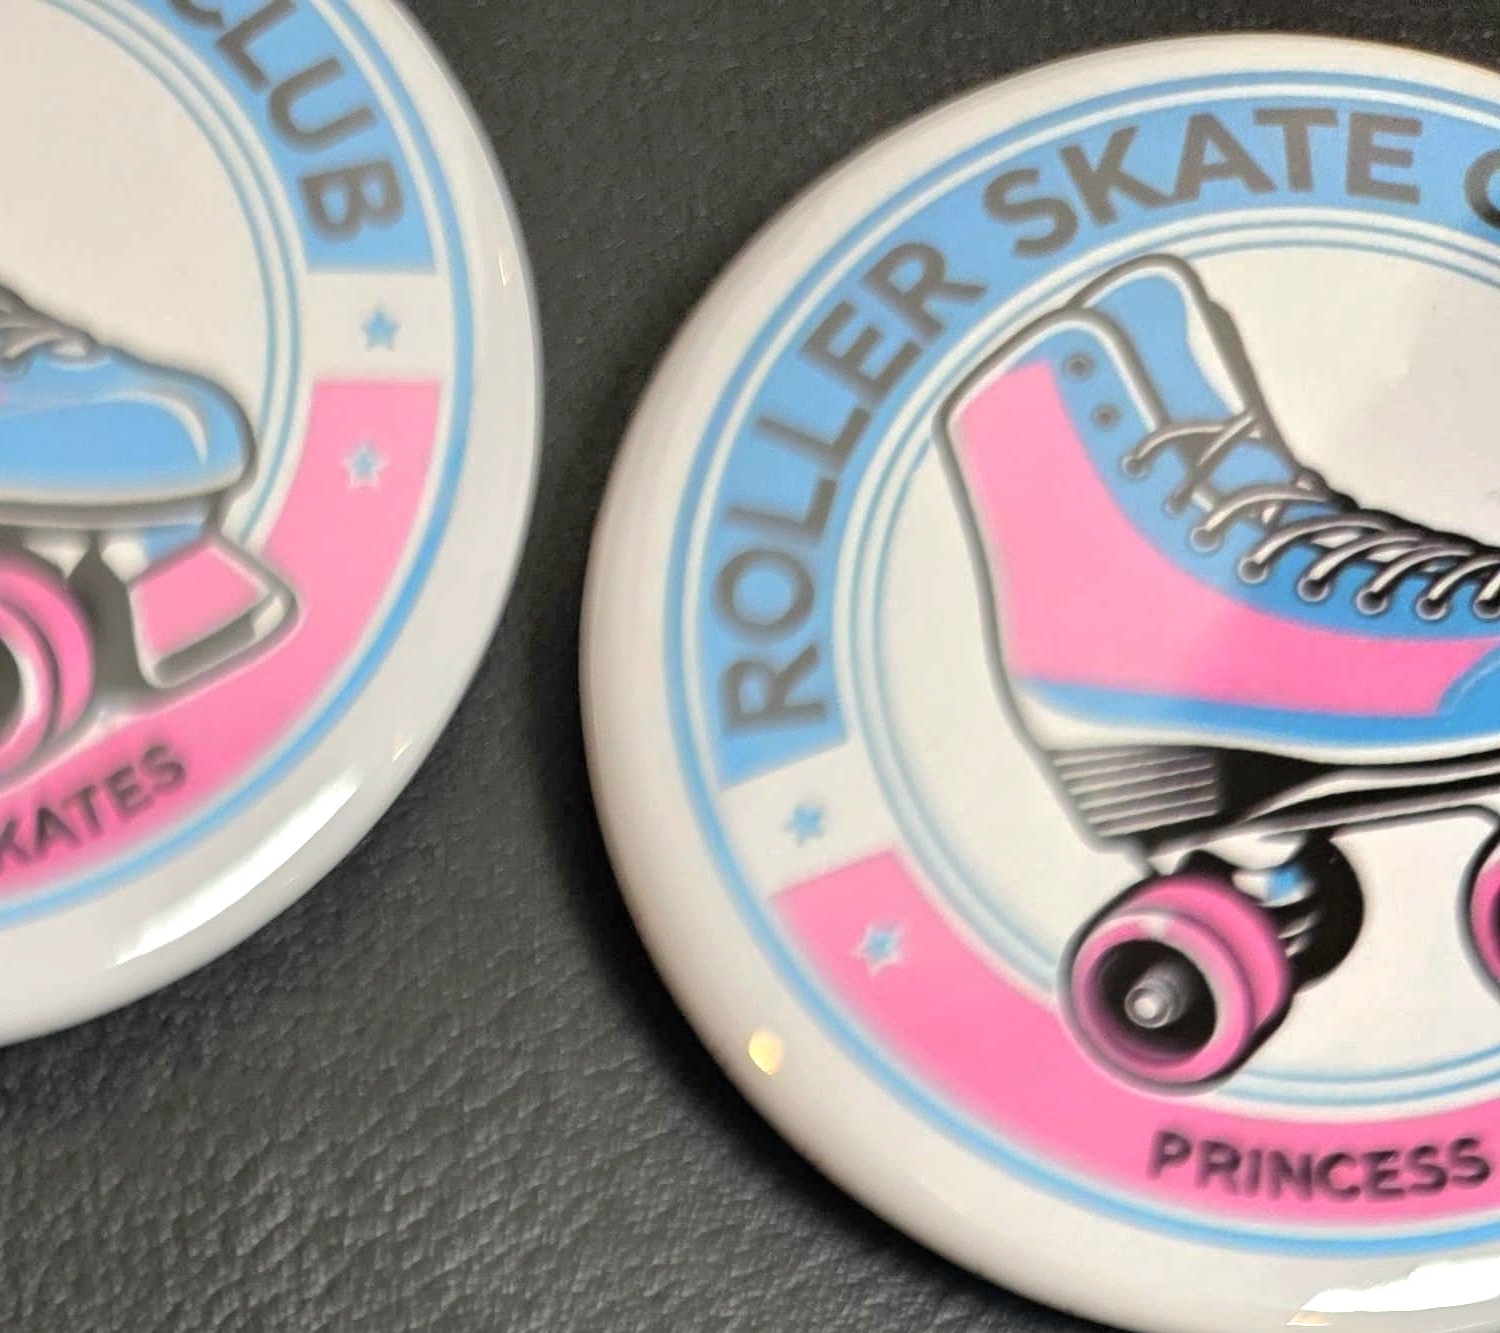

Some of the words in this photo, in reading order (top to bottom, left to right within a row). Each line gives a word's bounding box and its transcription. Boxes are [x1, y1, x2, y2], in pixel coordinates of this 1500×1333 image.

[168, 0, 405, 243] LUB
[712, 241, 988, 737] ROLLER
[982, 107, 1422, 259] SKATE
[1147, 1130, 1492, 1201] PRINCESS
